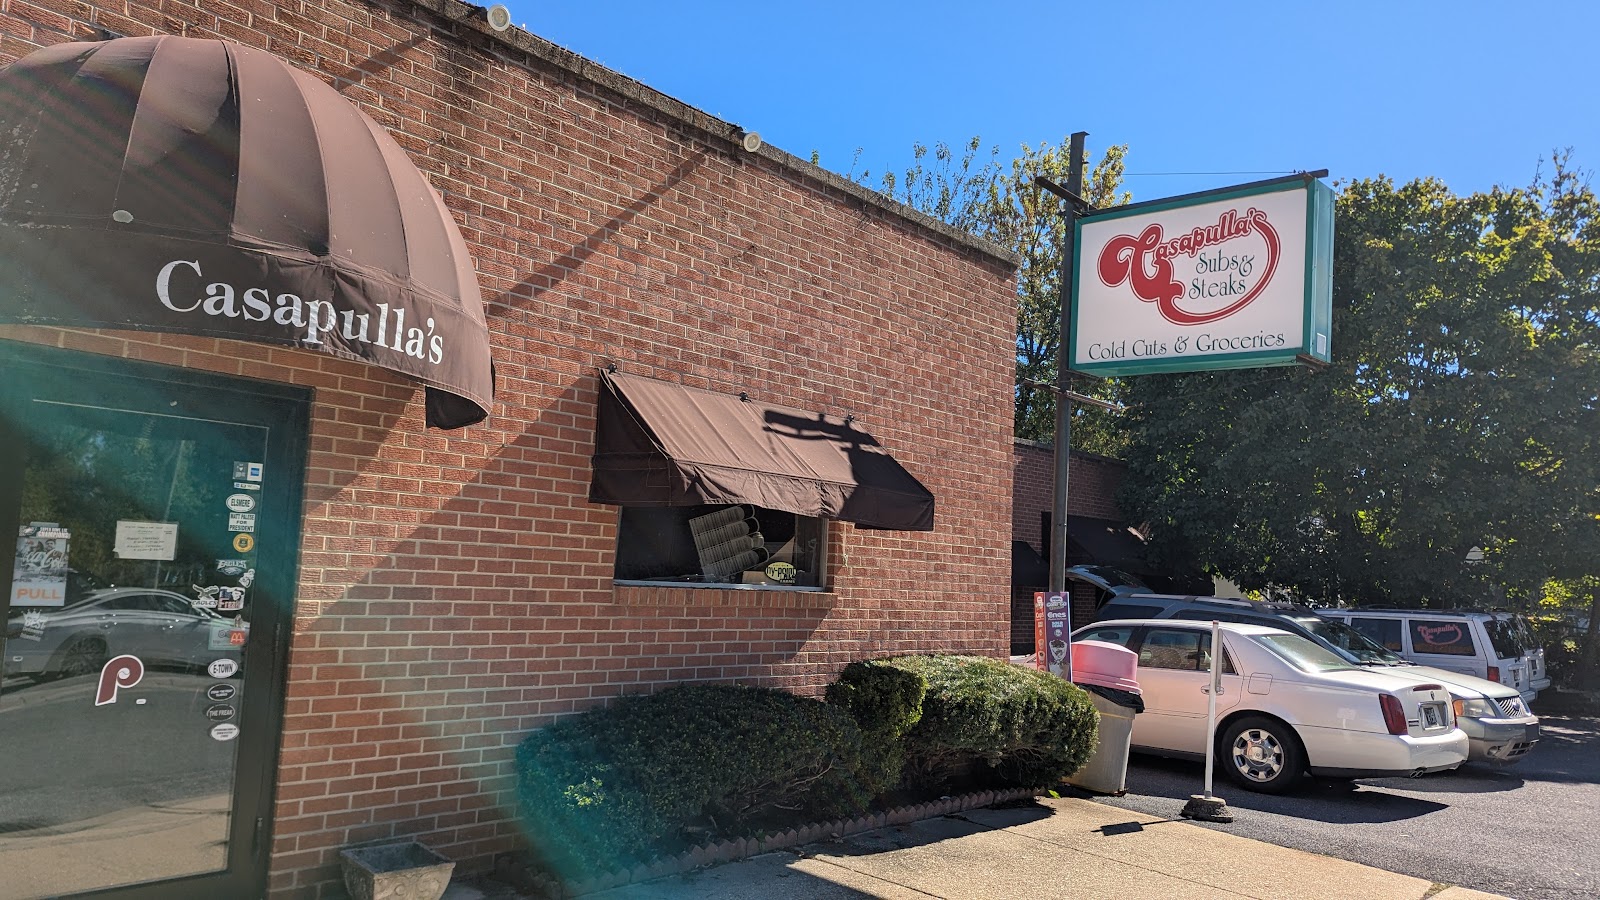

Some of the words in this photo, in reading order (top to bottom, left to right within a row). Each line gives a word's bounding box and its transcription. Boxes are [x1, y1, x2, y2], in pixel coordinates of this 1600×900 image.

[1097, 208, 1280, 320] Casapulla's
[1188, 273, 1247, 300] Steaks
[155, 259, 444, 365] Casapulla's
[1088, 341, 1126, 361] Cold
[1132, 339, 1168, 358] Cuts
[1174, 335, 1190, 354] &
[1196, 331, 1286, 353] Groceries
[230, 498, 251, 508] ELSMERE
[16, 587, 61, 600] PULL
[213, 663, 234, 674] E-TOWN
